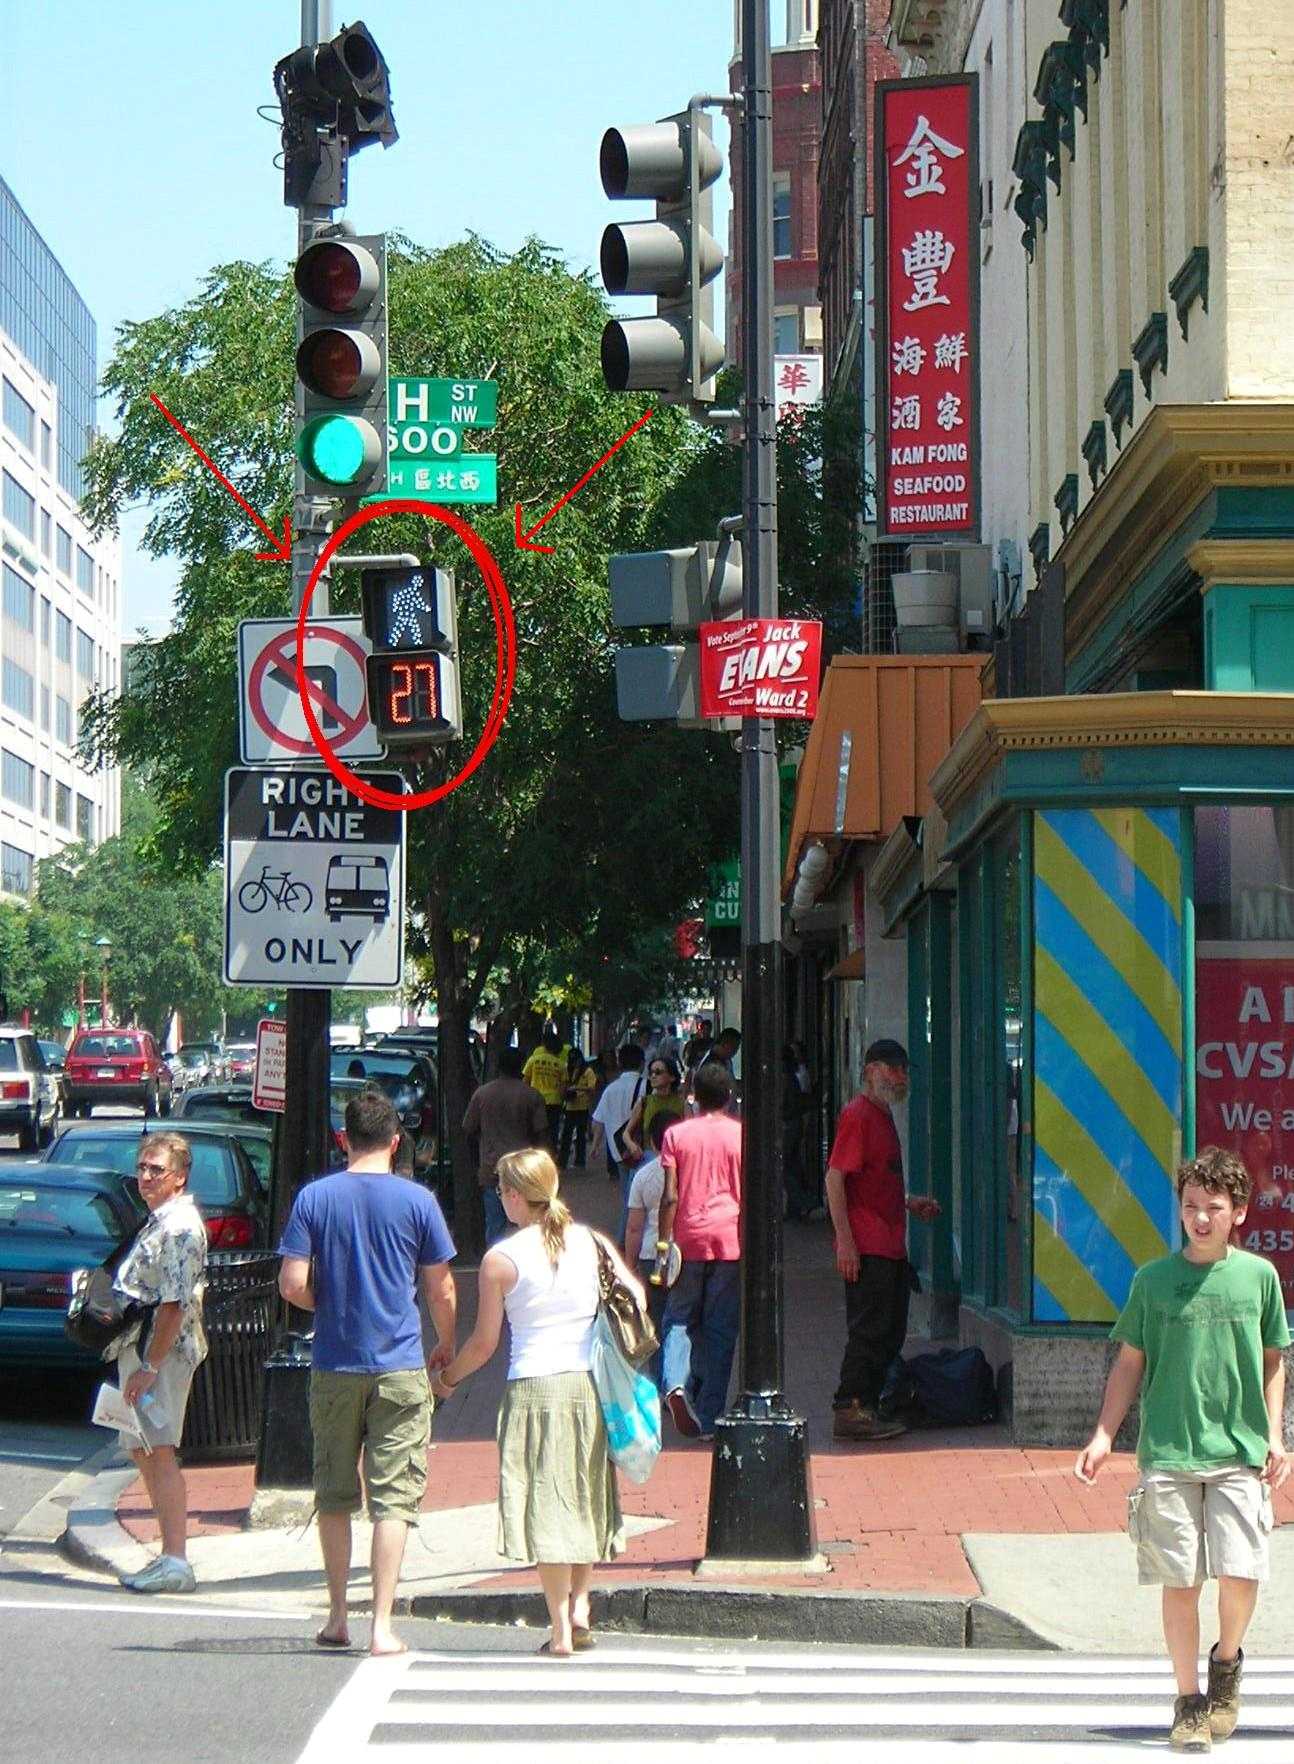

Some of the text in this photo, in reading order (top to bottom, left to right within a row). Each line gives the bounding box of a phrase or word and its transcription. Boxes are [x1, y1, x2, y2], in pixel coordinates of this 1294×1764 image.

[397, 383, 478, 422] H ST
[451, 405, 478, 423] NW
[891, 443, 968, 466] KAM FONG
[893, 475, 966, 496] SEAFOOD
[890, 503, 969, 524] RESTAURANT
[762, 622, 801, 643] Jack
[391, 663, 437, 723] 27
[756, 687, 798, 708] Ward
[797, 690, 809, 708] 2
[262, 777, 371, 808] RIGH
[268, 810, 365, 840] LANE
[265, 937, 362, 965] ONLY
[1238, 986, 1272, 1023] A
[1220, 1102, 1273, 1131] We
[1245, 1230, 1294, 1252] 435
